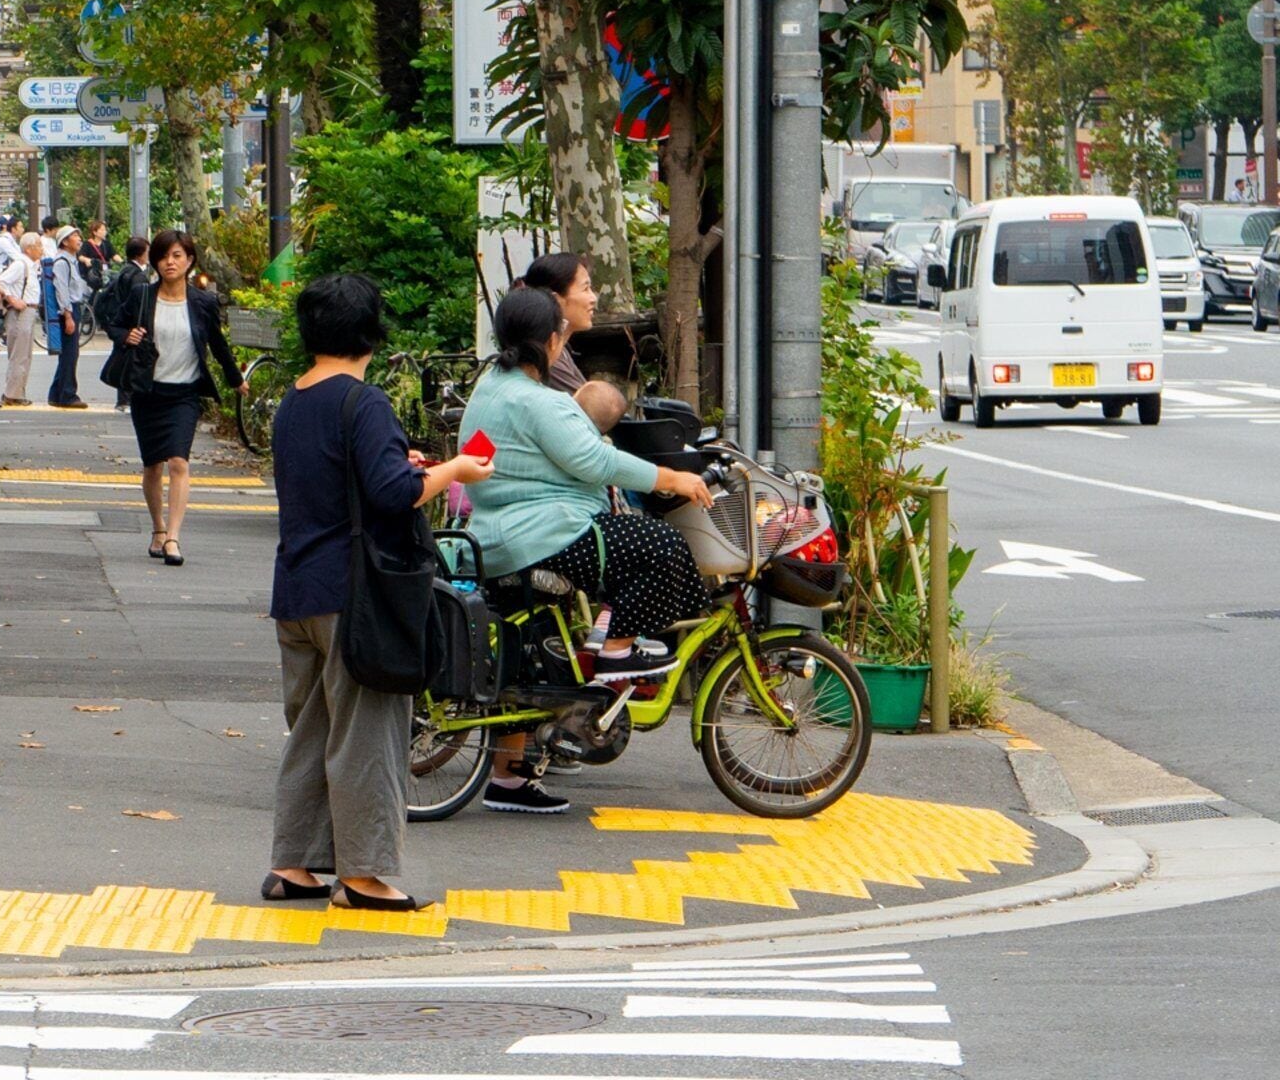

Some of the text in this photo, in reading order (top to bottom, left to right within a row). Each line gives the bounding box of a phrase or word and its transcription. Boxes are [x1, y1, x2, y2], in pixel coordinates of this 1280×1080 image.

[94, 106, 121, 117] 200m
[469, 88, 480, 127] 警視庁
[67, 133, 106, 143] Kokugikan
